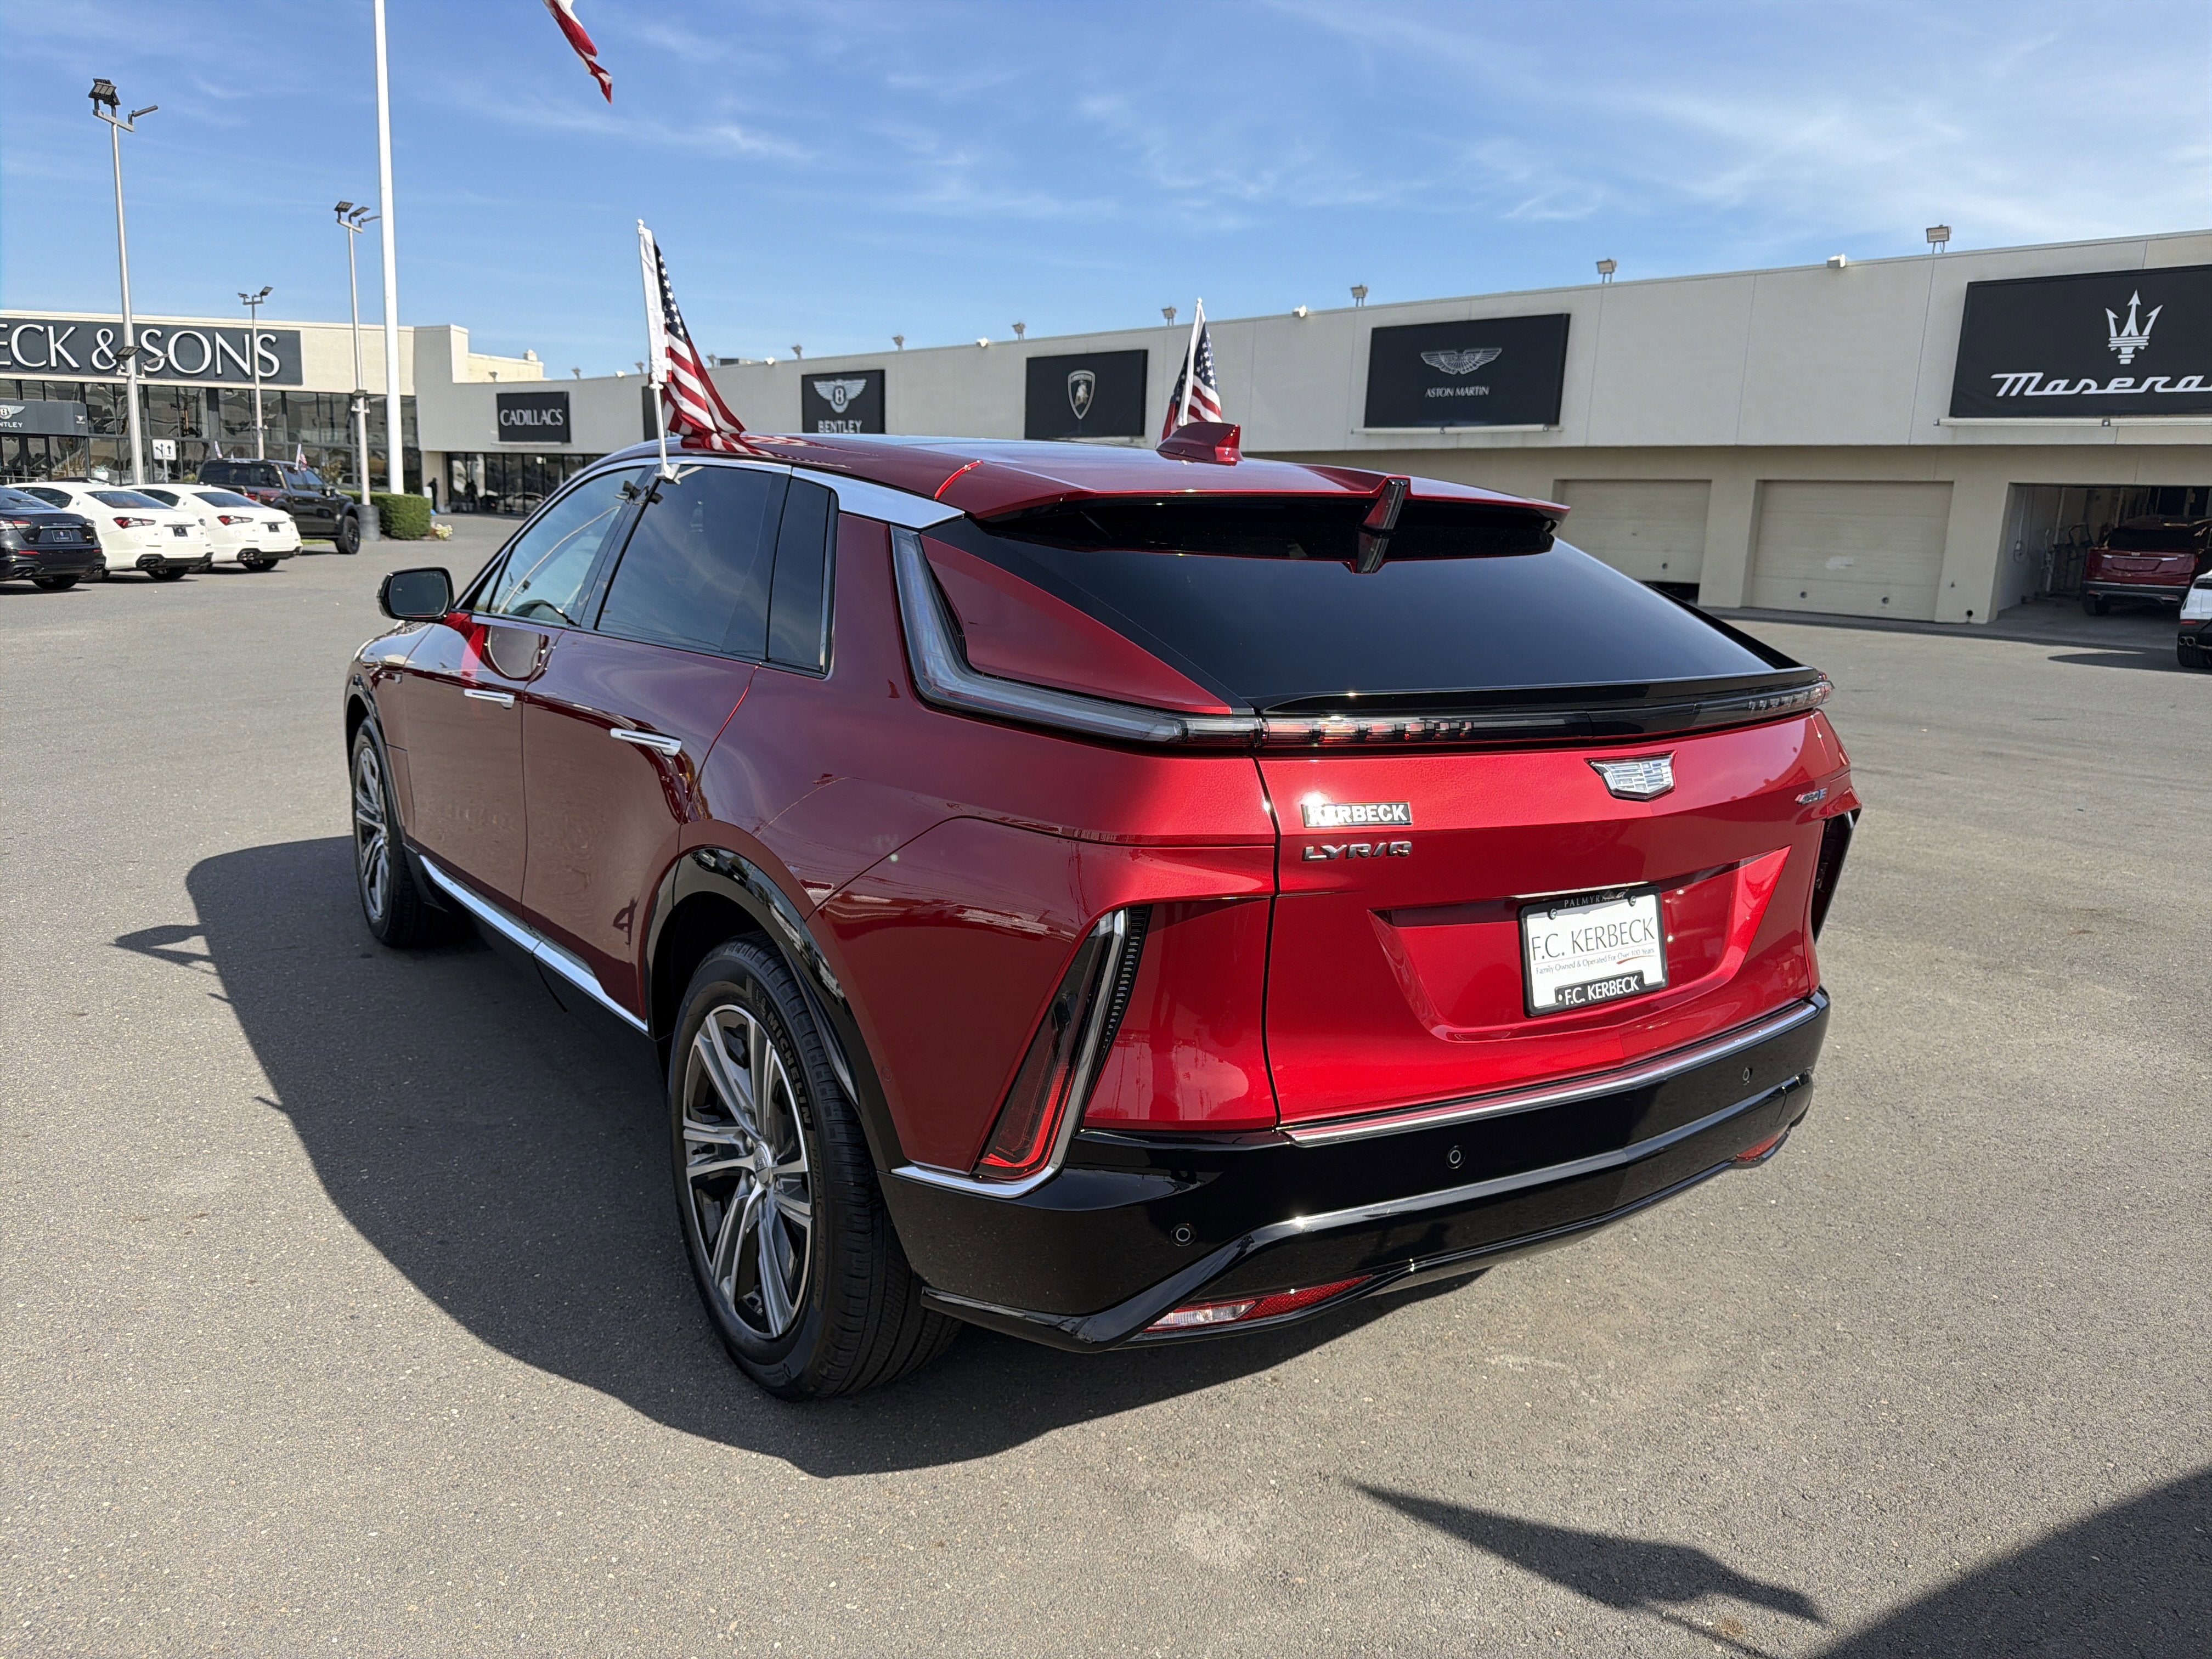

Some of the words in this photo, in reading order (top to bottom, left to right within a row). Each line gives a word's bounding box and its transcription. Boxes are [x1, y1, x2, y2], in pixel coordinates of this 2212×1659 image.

[92, 328, 126, 370] &
[140, 329, 281, 378] SONS
[1425, 387, 1454, 398] ASTON
[1454, 385, 1491, 397] MARTIN
[500, 408, 563, 426] CADILLACS
[817, 419, 862, 433] BENTLEY
[1307, 804, 1408, 825] KERBECK
[1531, 933, 1565, 961] F.C.
[1571, 917, 1655, 954] KERBECK
[1536, 965, 1554, 975] Family
[1555, 960, 1576, 971] Owned
[1582, 954, 1607, 968] Operated
[1607, 953, 1616, 962] For
[1617, 951, 1630, 960] Over
[1641, 947, 1655, 956] Years
[1564, 987, 1585, 1006] F.C.
[1587, 975, 1639, 1001] KERBECK
[767, 1011, 811, 1124] MICHELIN
